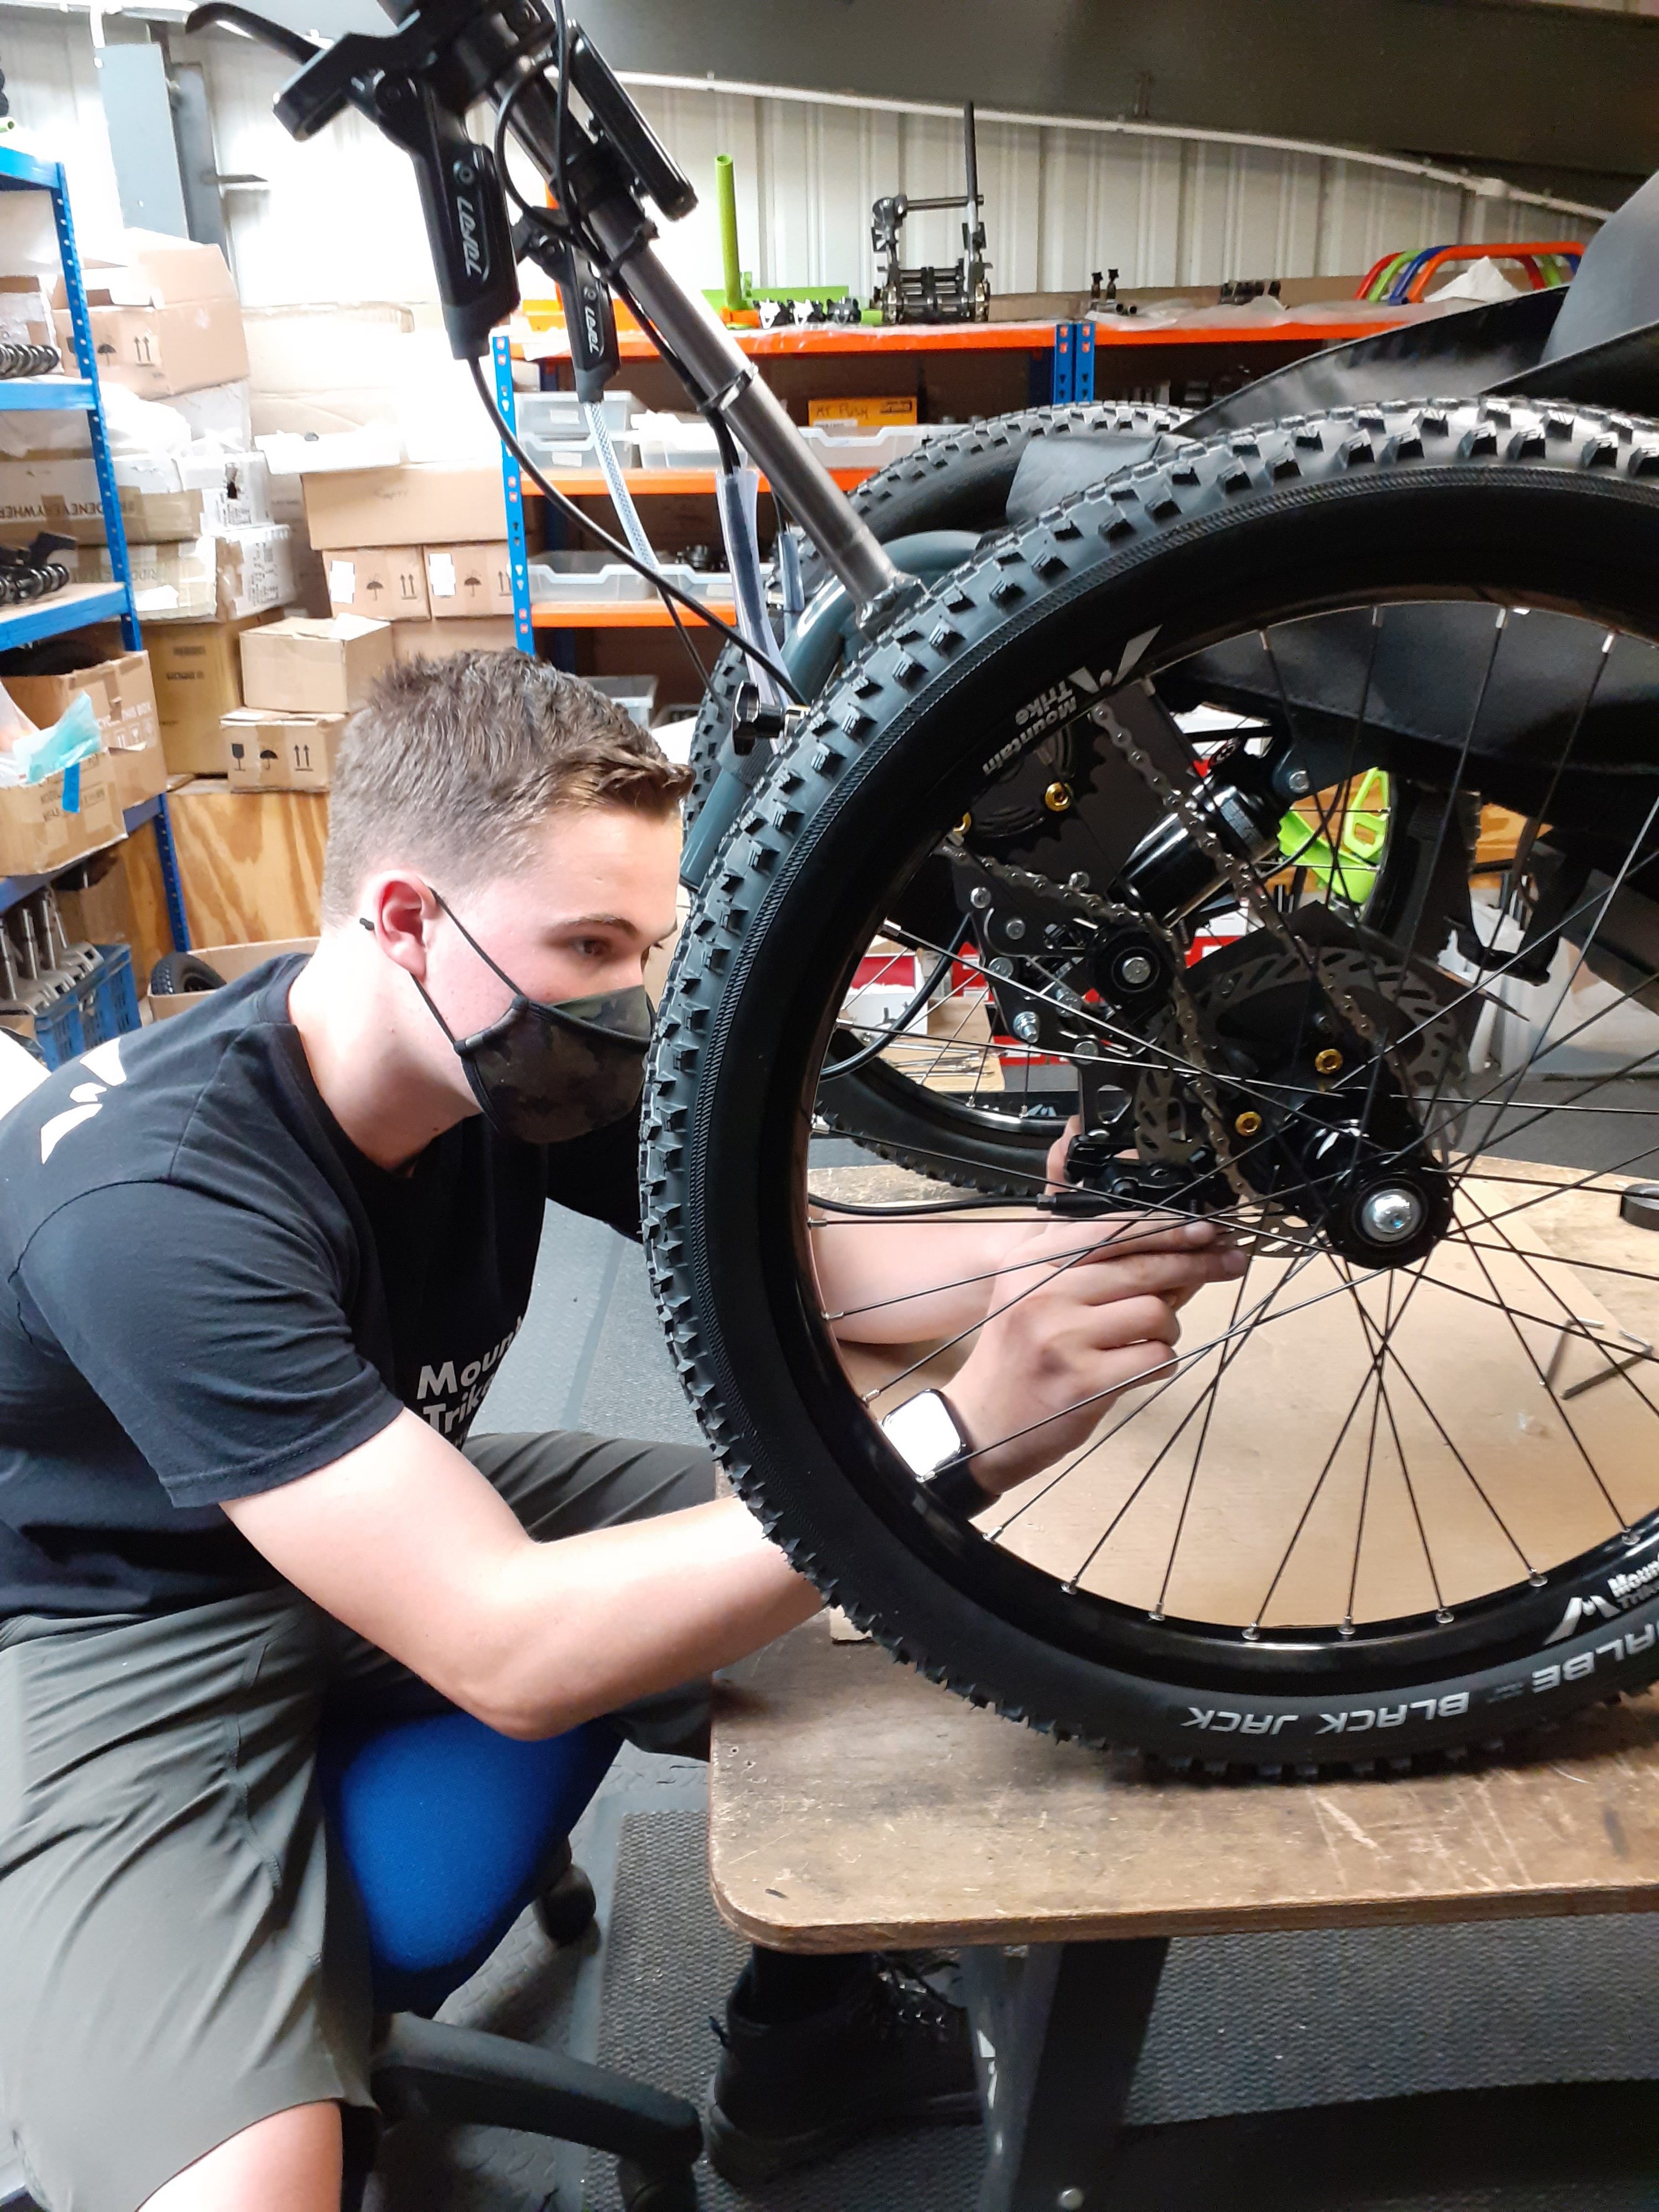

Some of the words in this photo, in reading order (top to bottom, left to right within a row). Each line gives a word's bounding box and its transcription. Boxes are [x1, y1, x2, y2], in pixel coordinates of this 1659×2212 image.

[1015, 680, 1073, 726] Trike
[982, 696, 1077, 776] Mountain
[1607, 1552, 1659, 1598] Moun
[1531, 1622, 1659, 1693] ALBE
[1181, 1706, 1298, 1735] JACK
[1315, 1692, 1470, 1735] BLACK
